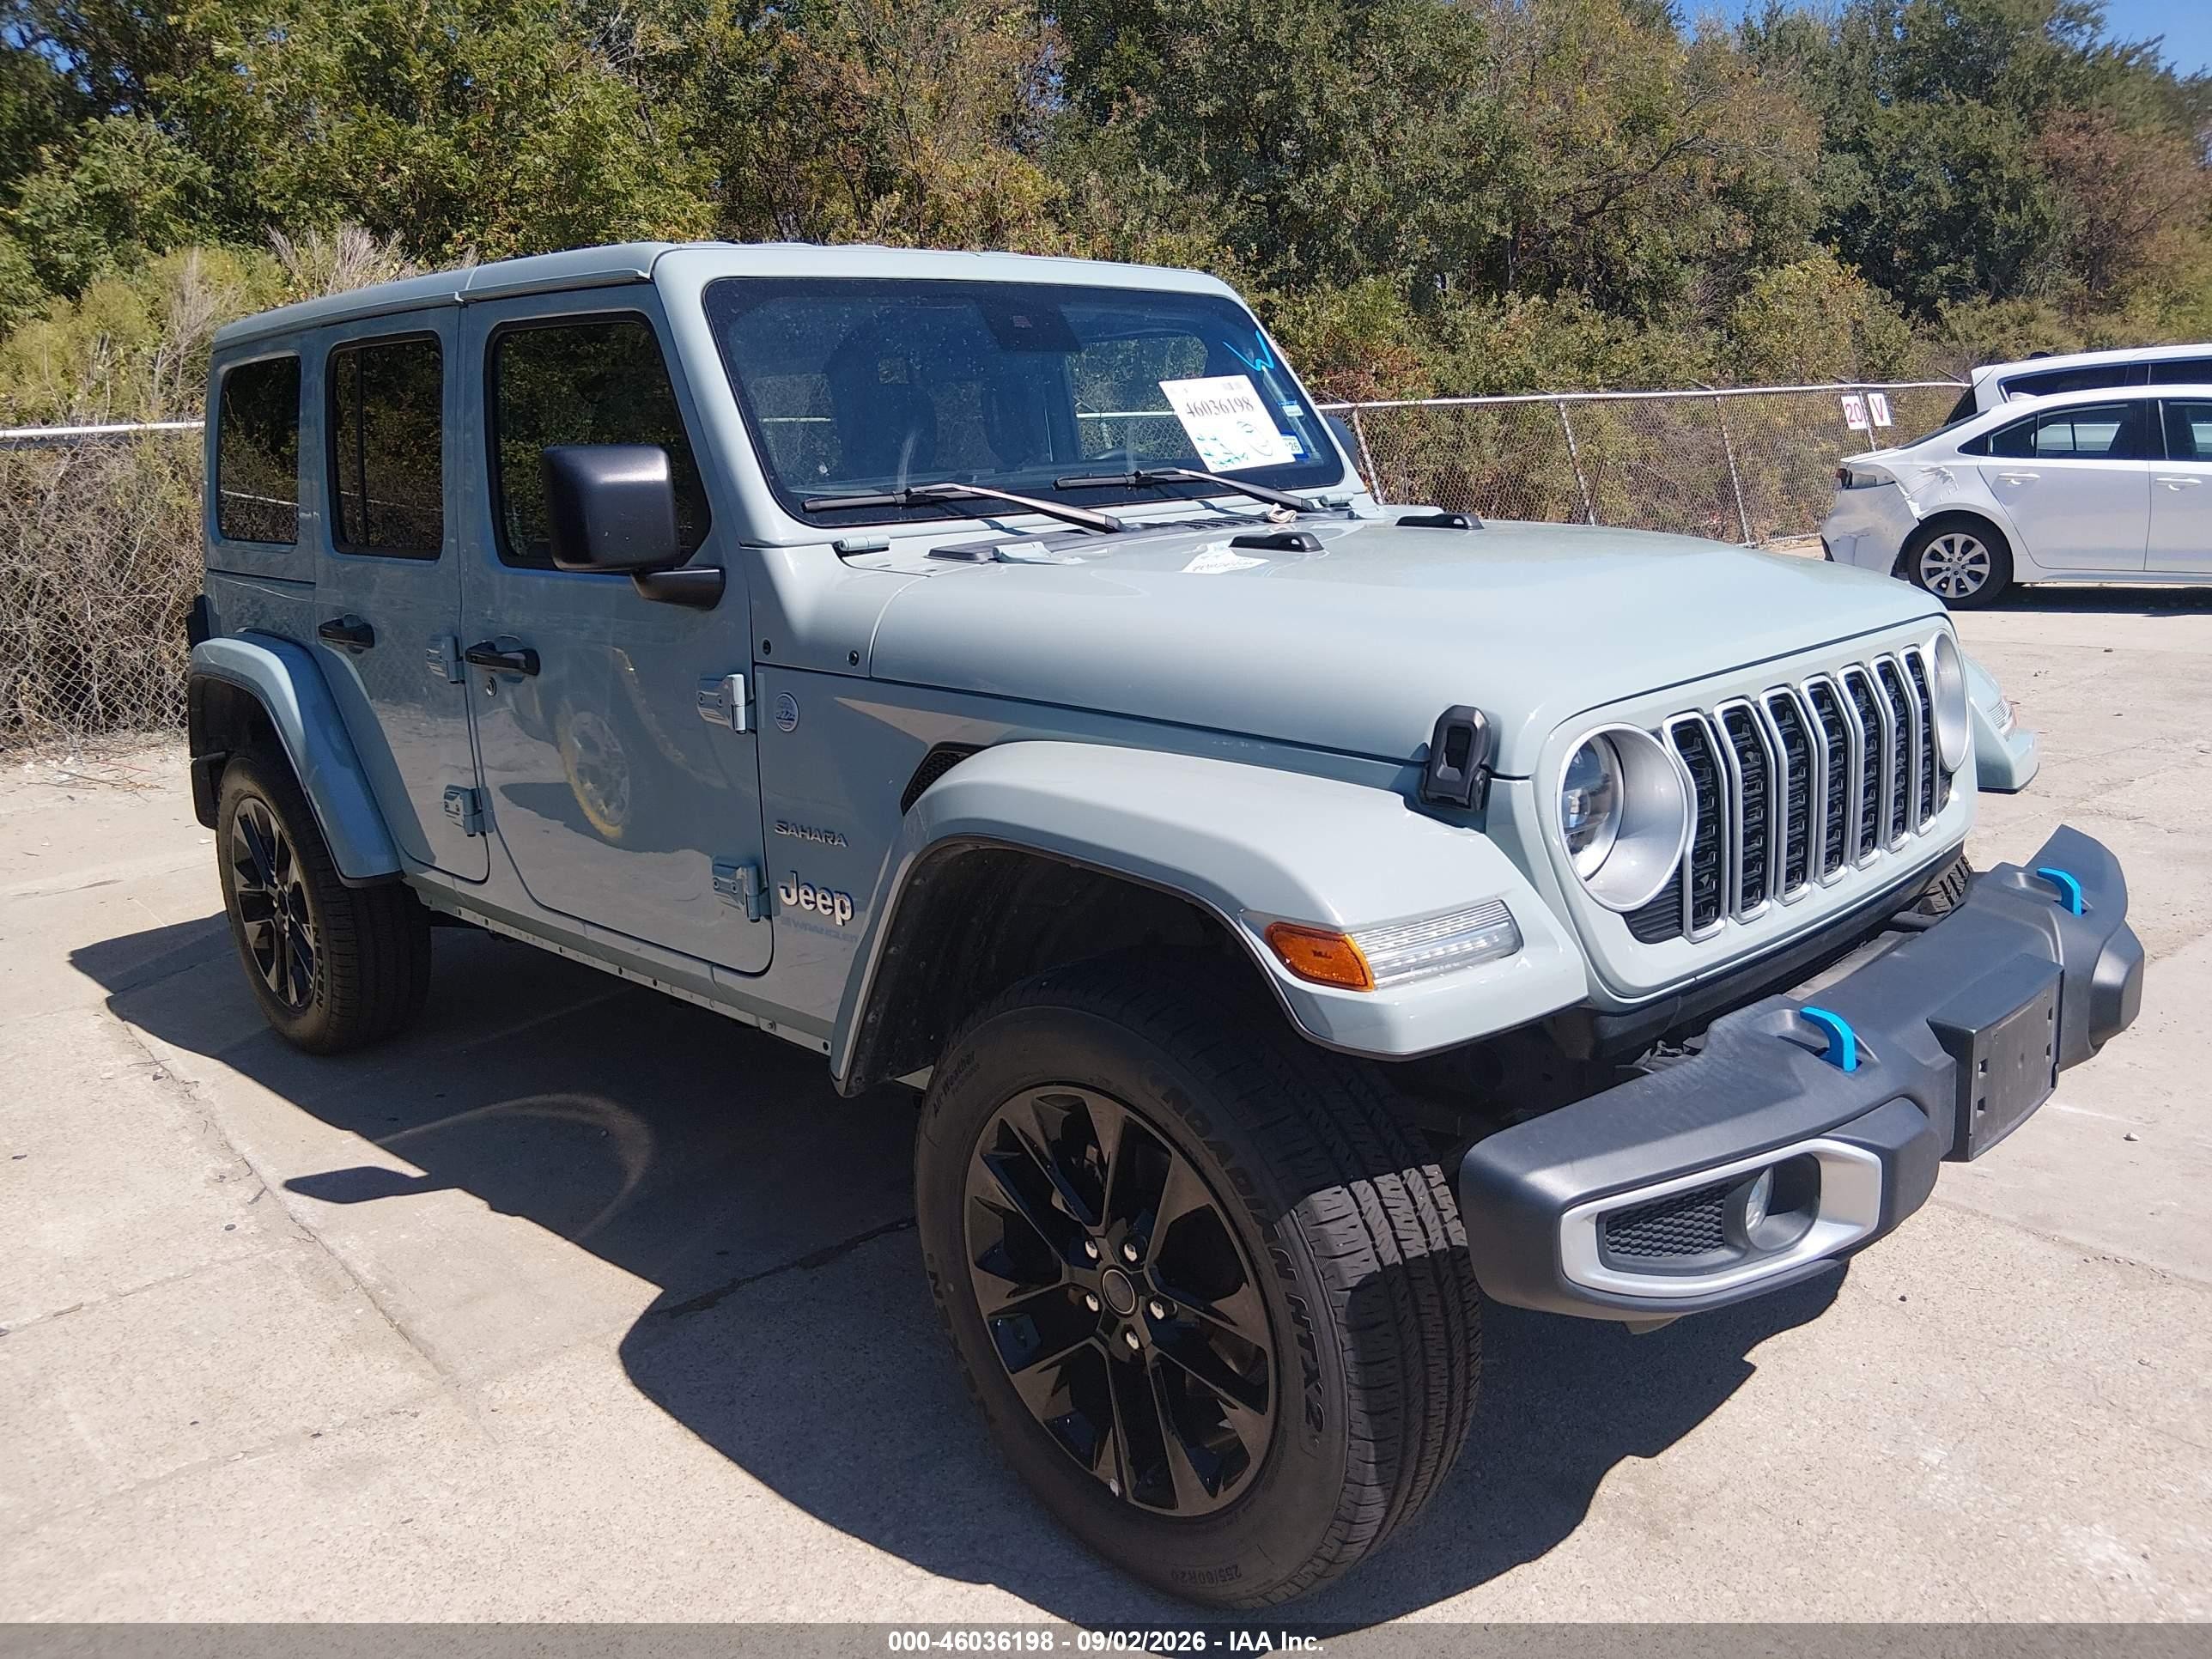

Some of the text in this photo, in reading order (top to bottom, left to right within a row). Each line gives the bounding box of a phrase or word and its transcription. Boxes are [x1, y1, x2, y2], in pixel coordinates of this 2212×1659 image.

[1186, 396, 1255, 418] 46036198
[1845, 403, 1863, 422] 20
[1872, 398, 1883, 421] V
[775, 820, 849, 848] SAHARA
[779, 870, 854, 927] Jeep
[1285, 1290, 1326, 1434] HTX2
